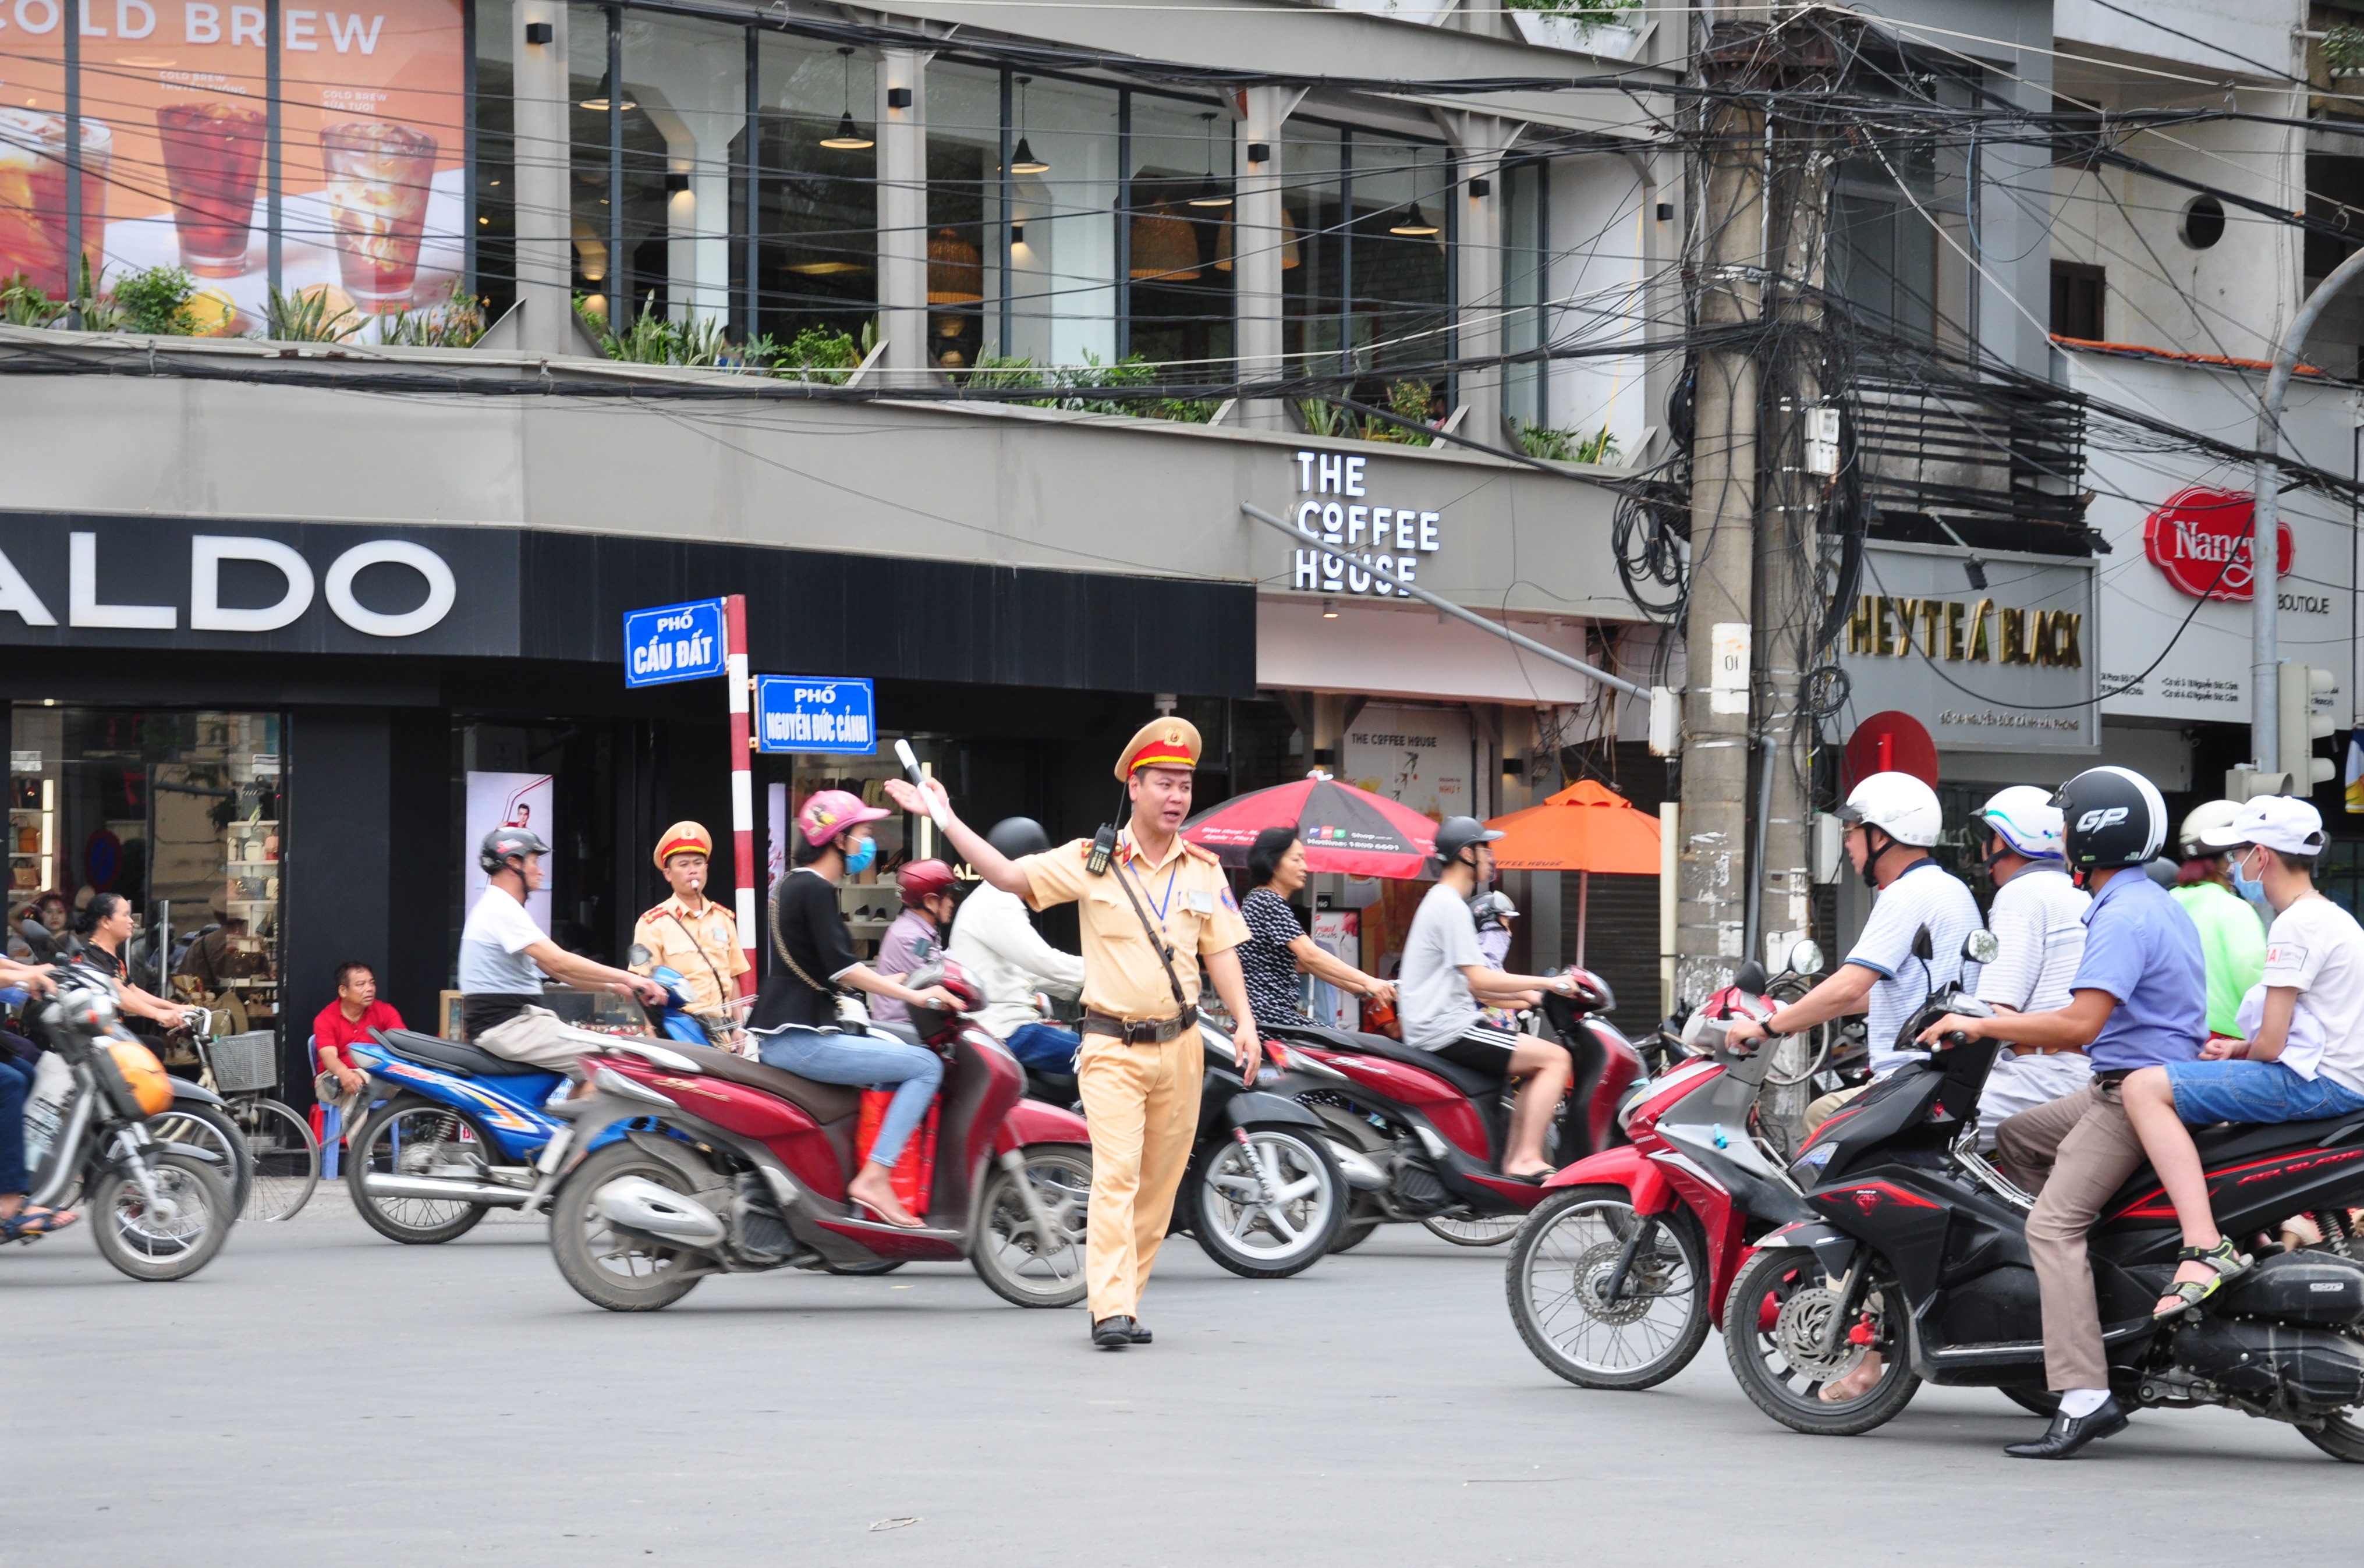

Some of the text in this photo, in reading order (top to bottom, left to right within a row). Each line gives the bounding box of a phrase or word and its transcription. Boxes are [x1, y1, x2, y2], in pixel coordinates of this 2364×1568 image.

[0, 0, 385, 55] OLD BREW
[160, 70, 226, 83] COLD BREW
[323, 90, 388, 102] COLD BREW
[1298, 451, 1366, 496] THE
[1298, 500, 1440, 551] COFFEE
[1296, 548, 1417, 595] HOUSE
[2278, 594, 2329, 614] BOUTIQUE
[657, 608, 693, 633] PHỐ
[676, 629, 713, 669] ĐẤT
[2000, 607, 2082, 668] BLACK
[794, 684, 837, 704] PHỐ
[766, 705, 868, 743] NGUYỄN ĐỨC CẢNH
[1352, 733, 1437, 747] THE COFFEE HOUSE
[2076, 807, 2129, 834] GP
